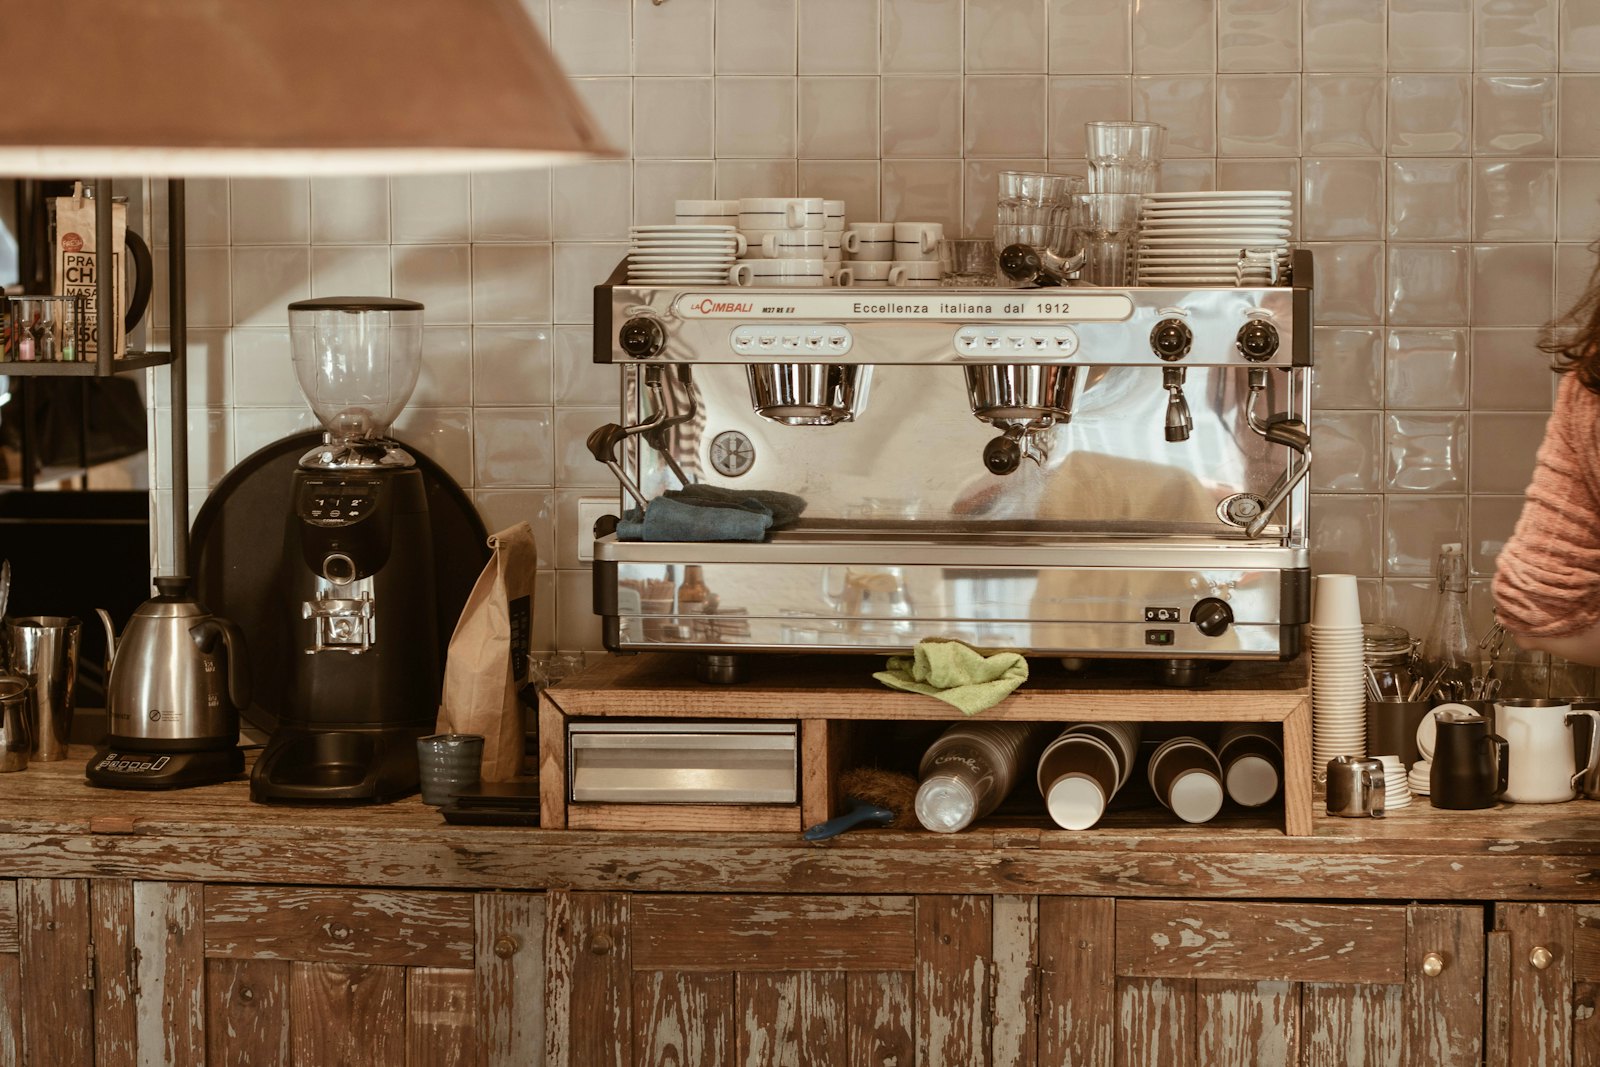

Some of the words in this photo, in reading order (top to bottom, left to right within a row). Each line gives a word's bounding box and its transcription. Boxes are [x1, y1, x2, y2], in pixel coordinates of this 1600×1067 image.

[853, 302, 929, 314] Eccellenza
[940, 302, 992, 314] italiana
[1003, 302, 1025, 314] dal
[1036, 303, 1070, 314] 1912
